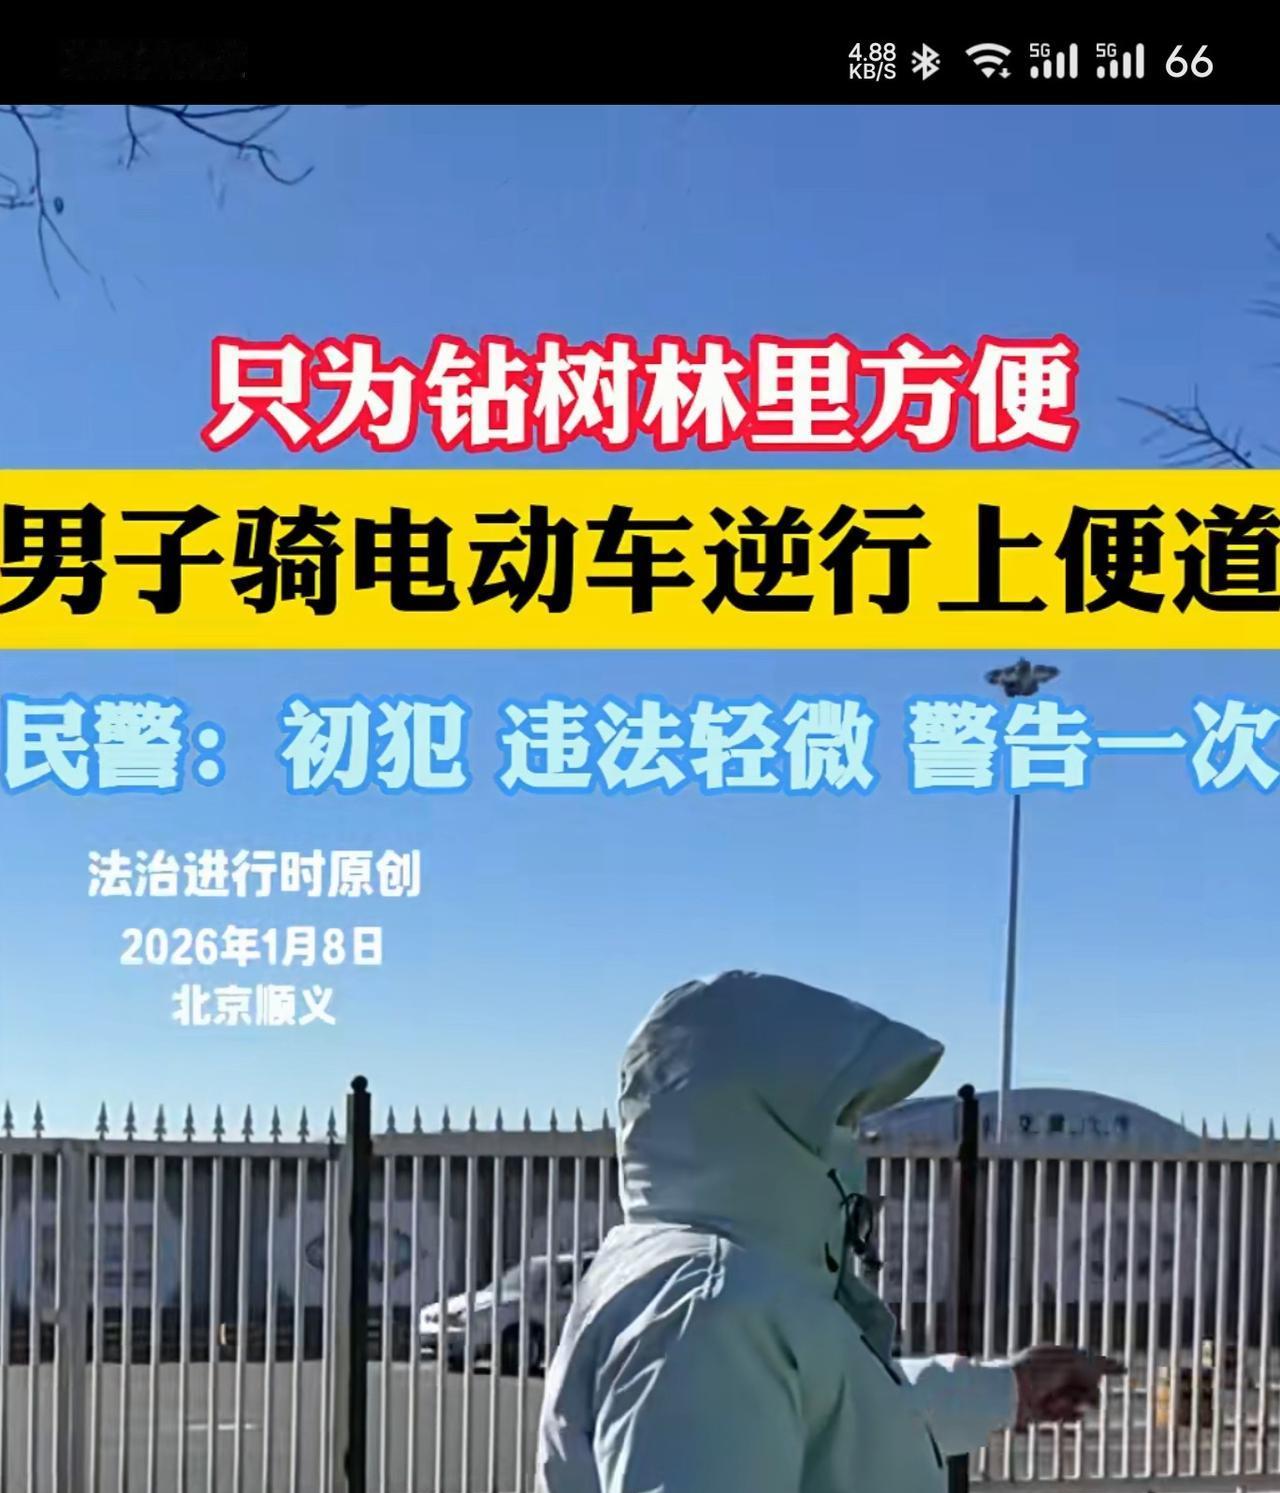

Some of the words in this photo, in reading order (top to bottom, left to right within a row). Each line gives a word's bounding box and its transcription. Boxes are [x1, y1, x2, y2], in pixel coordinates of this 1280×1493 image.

[848, 42, 897, 62] 4.88
[1029, 43, 1051, 57] 5G
[1096, 43, 1118, 57] 5G
[1165, 44, 1214, 78] 66
[848, 63, 897, 82] KB/S
